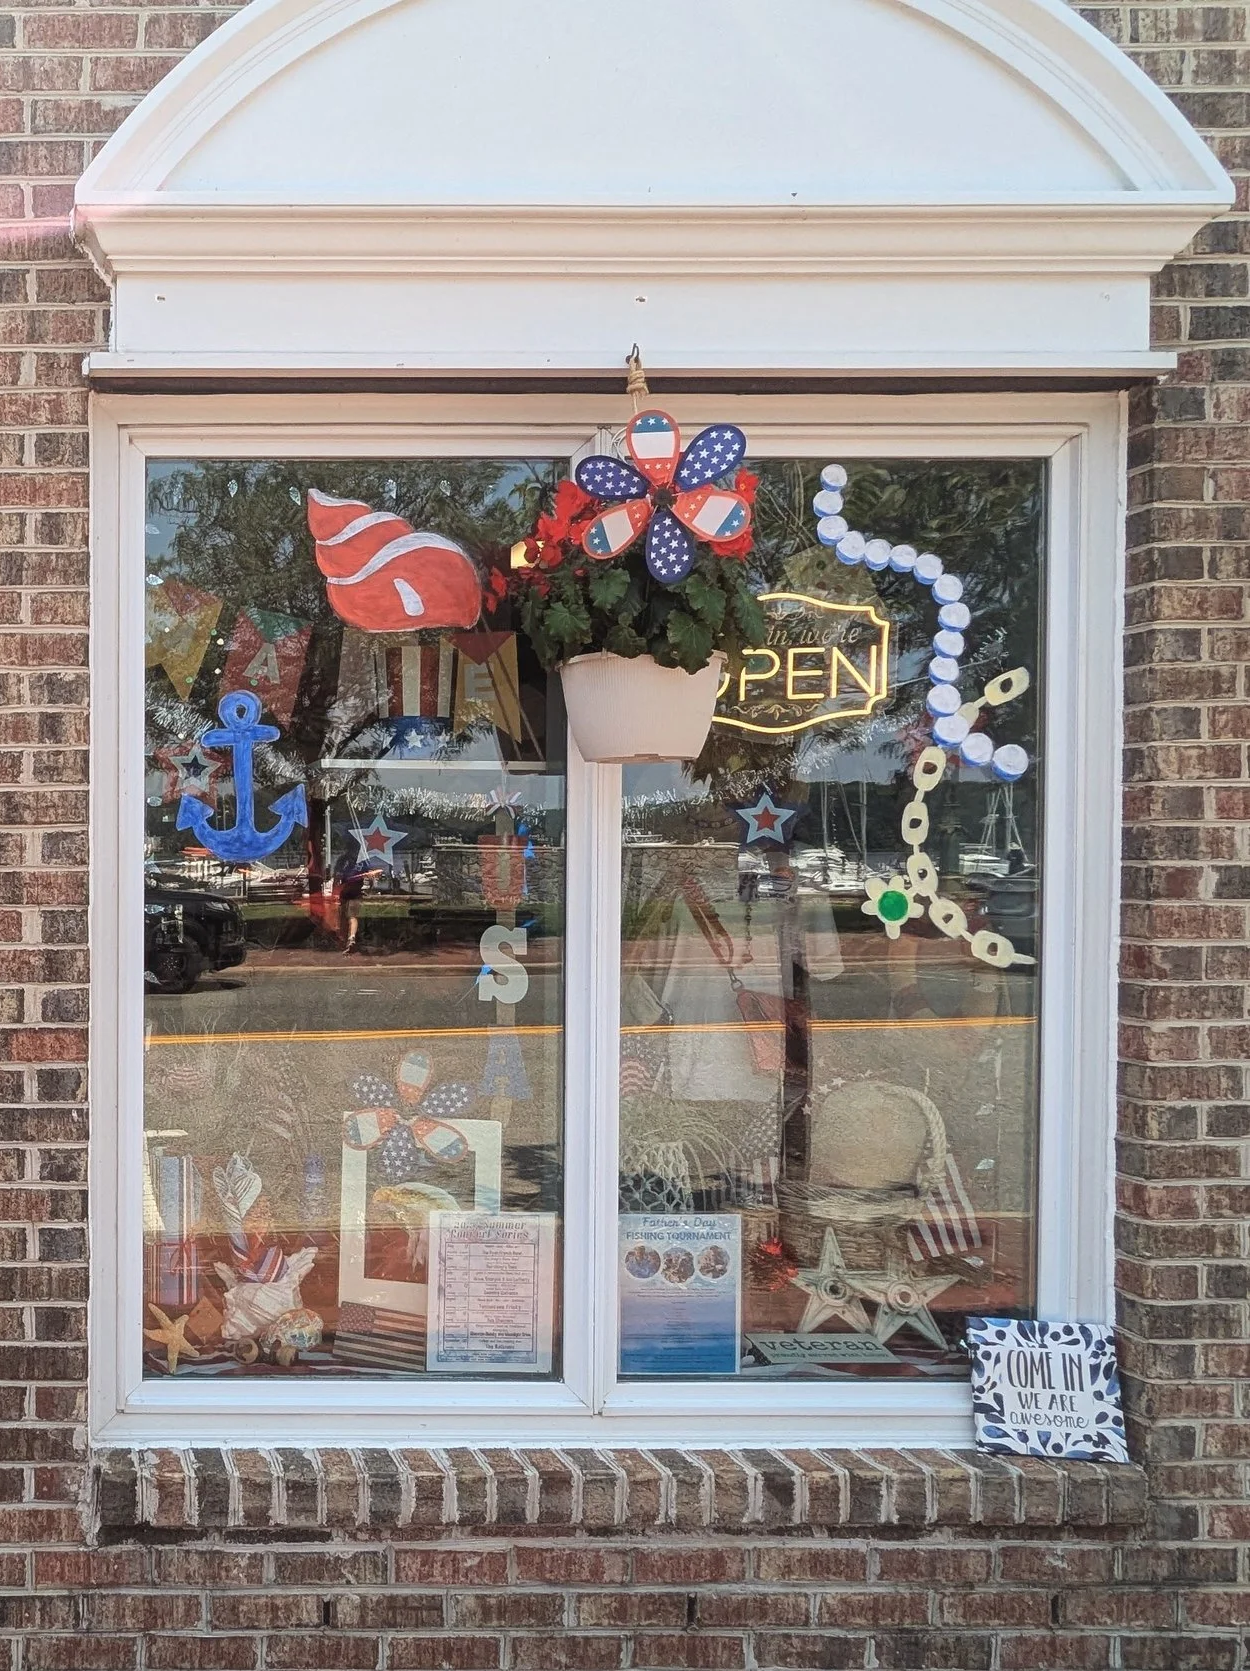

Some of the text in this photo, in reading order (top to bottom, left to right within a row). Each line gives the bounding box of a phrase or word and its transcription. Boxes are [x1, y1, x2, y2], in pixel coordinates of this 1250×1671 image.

[242, 642, 280, 684] A
[716, 645, 878, 702] PEN
[484, 1221, 526, 1230] Summer
[626, 1231, 732, 1240] FISHING TOURNAMENT
[759, 1337, 883, 1351] veteran
[1006, 1350, 1084, 1392] COME IN
[1017, 1391, 1078, 1413] WE ARE
[1010, 1411, 1089, 1429] awesome
